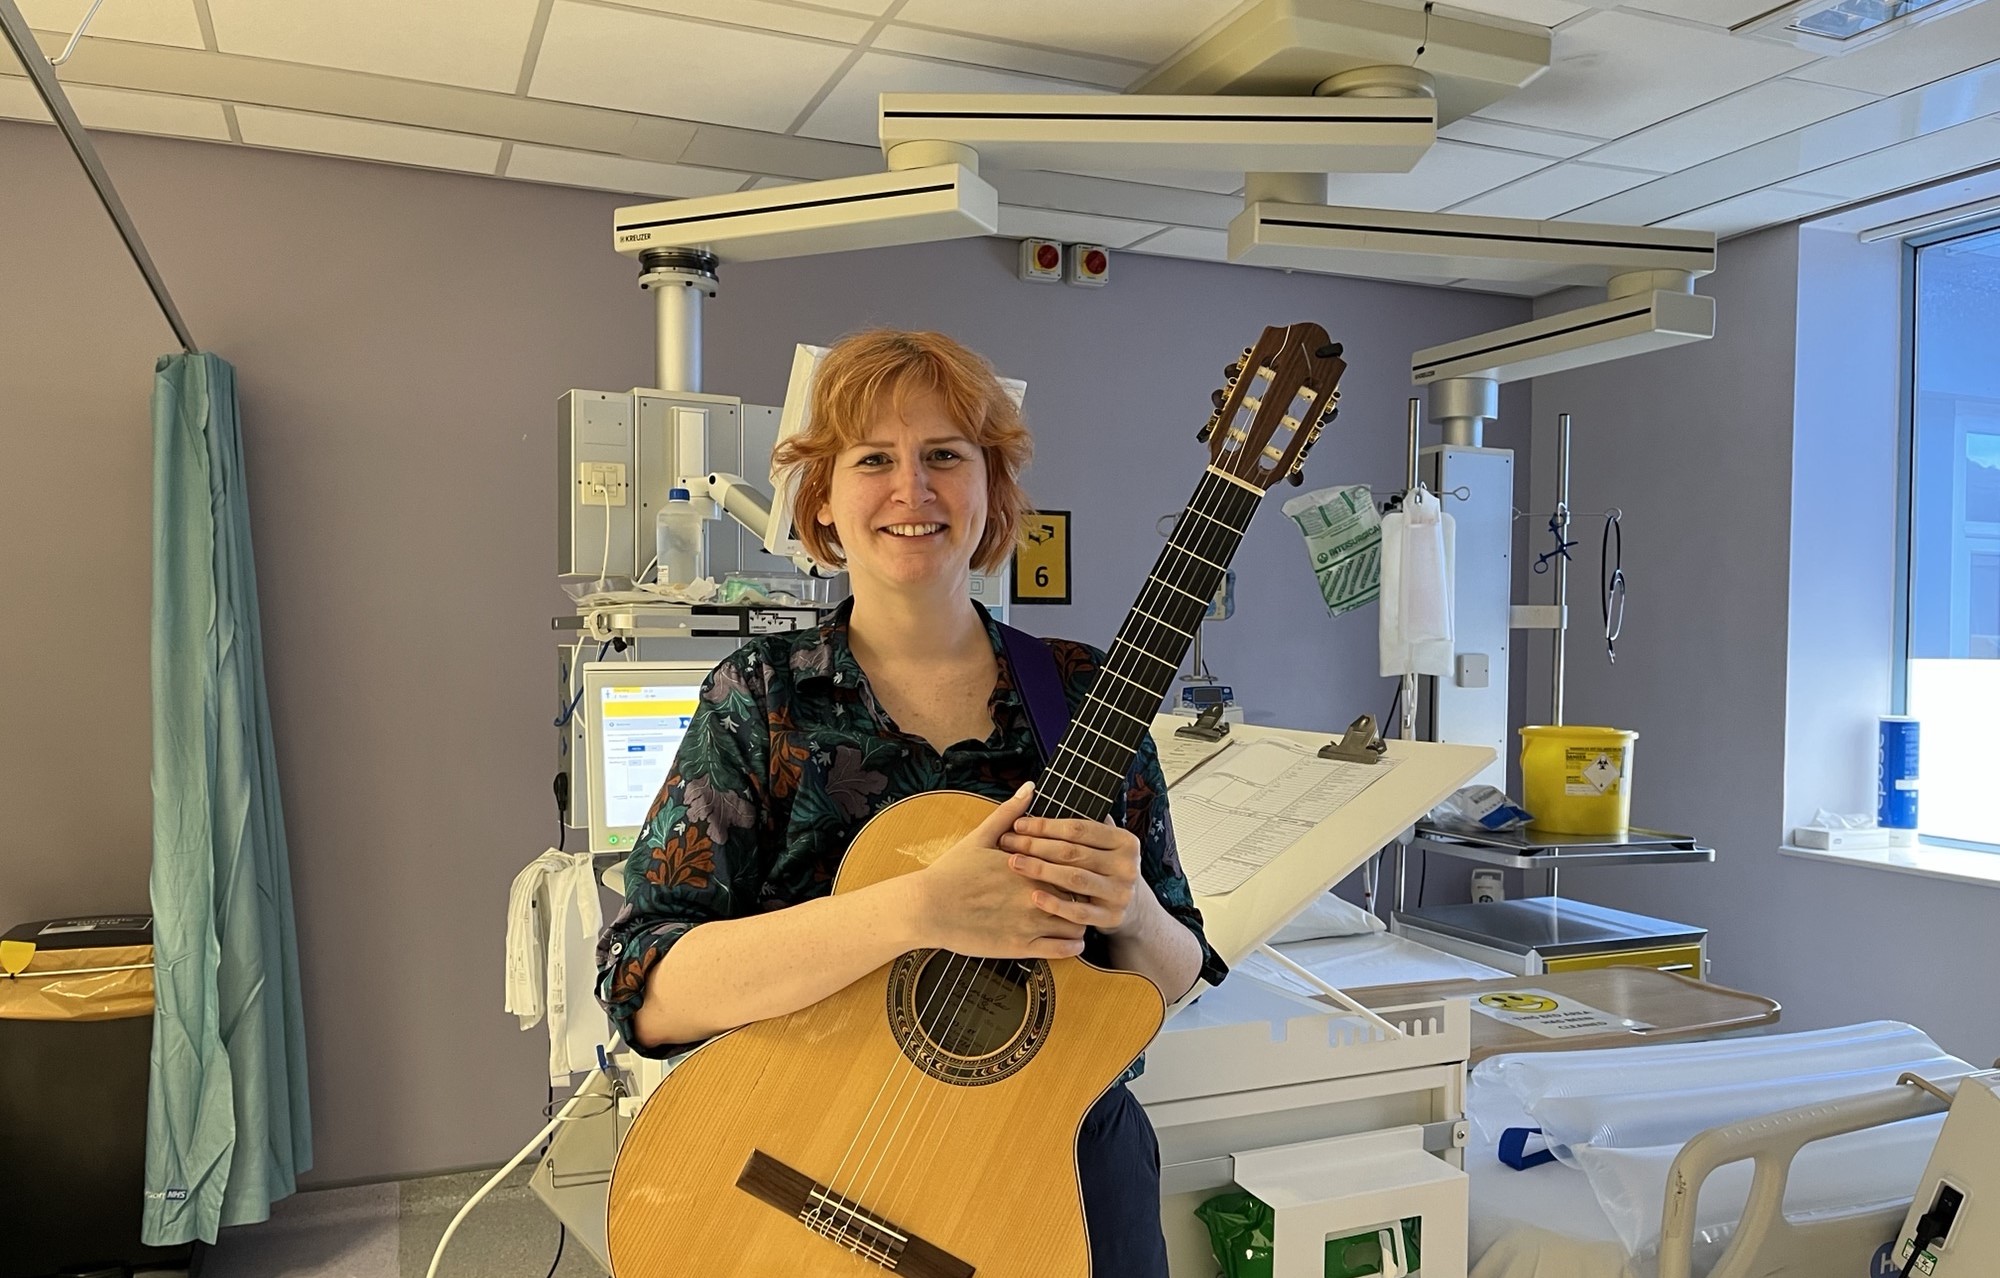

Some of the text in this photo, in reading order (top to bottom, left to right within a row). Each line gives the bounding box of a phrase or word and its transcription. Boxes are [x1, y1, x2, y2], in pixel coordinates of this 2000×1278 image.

[626, 233, 651, 242] KREUZER
[1035, 566, 1049, 588] 6
[1558, 1021, 1607, 1029] CLEANED
[167, 1190, 186, 1199] NHS
